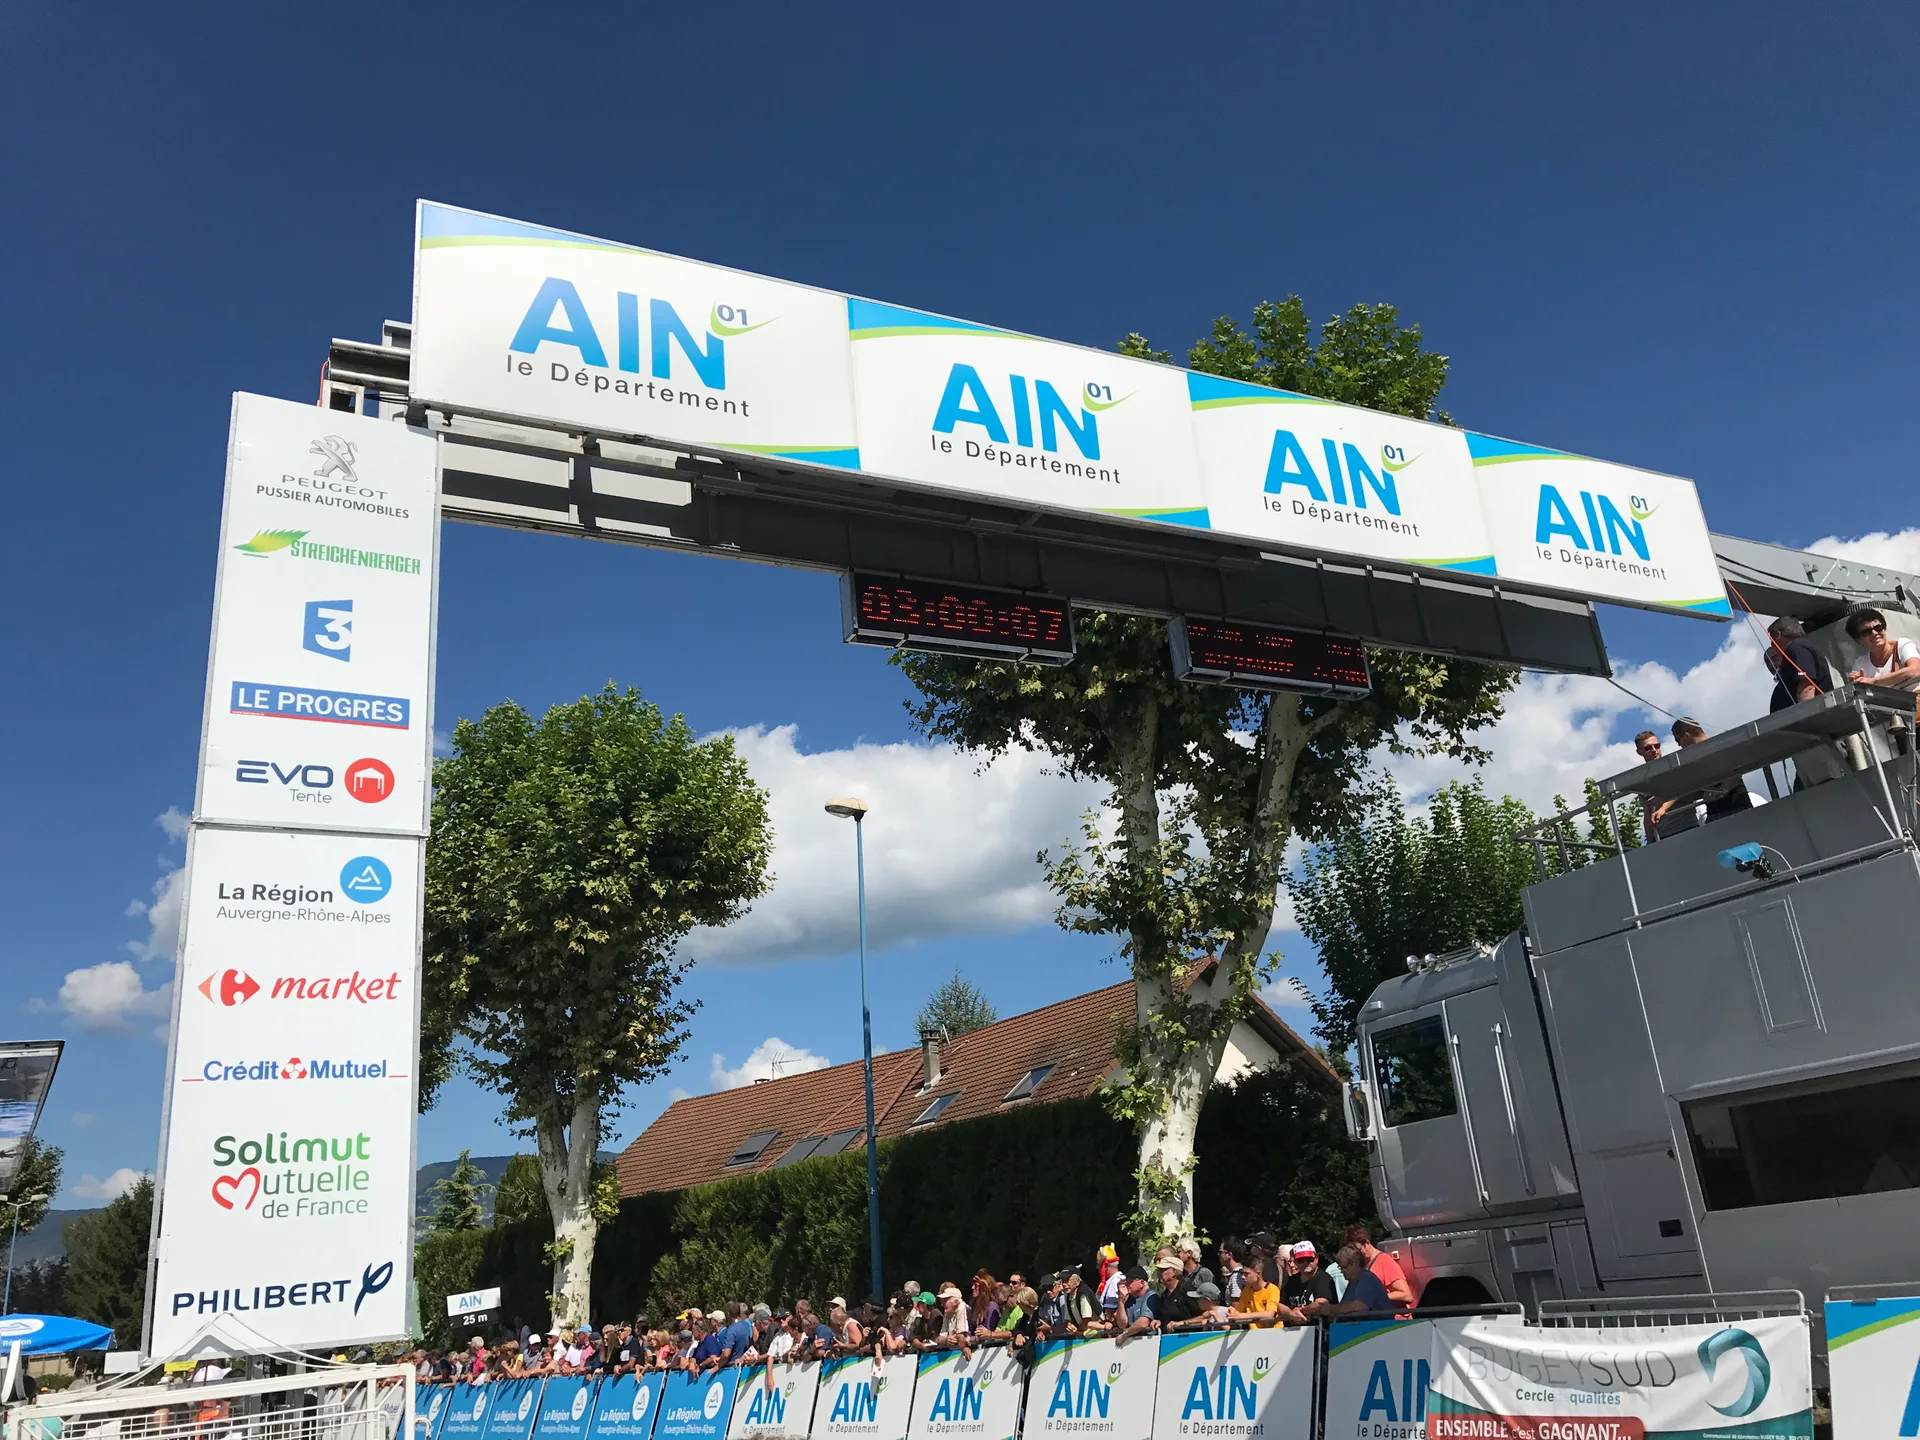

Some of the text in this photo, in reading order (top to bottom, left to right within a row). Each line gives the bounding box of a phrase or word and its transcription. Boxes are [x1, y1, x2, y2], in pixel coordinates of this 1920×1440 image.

[716, 303, 748, 326] 01
[508, 276, 726, 390] AIN
[507, 354, 750, 417] le Département
[1086, 382, 1113, 401] 01
[932, 362, 1101, 461] AIN
[931, 434, 1121, 484] le Département
[1383, 444, 1405, 462] 01
[1263, 429, 1402, 517] AIN
[281, 474, 389, 500] PEUGEOT
[256, 484, 410, 519] PUSSIER AUTOMOBILES
[1630, 493, 1649, 512] 01
[1263, 495, 1420, 537] le Département
[1535, 483, 1651, 561] AIN
[290, 539, 421, 575] STREICHENBERGER
[1536, 545, 1668, 581] le Département
[314, 607, 353, 651] 3
[238, 687, 403, 722] LE PROGRÈS
[236, 759, 334, 789] EVO
[289, 788, 333, 804] Tente
[218, 882, 334, 905] La Région
[216, 906, 391, 925] Auvergne-Rhône-Alpes
[270, 970, 402, 1004] market
[203, 1059, 387, 1081] Crédit Mutuel
[213, 1131, 371, 1167] Solimut
[262, 1198, 369, 1219] de France
[172, 1279, 352, 1317] PHILIBERT
[459, 1295, 482, 1309] AIN
[463, 1313, 488, 1326] 25 m
[1110, 1362, 1122, 1374] 01
[1256, 1356, 1269, 1370] 01
[787, 1382, 795, 1391] 01
[879, 1376, 888, 1386] 01
[983, 1370, 993, 1381] 01
[830, 1382, 878, 1422] AIN
[929, 1377, 983, 1422] AIN
[1047, 1369, 1111, 1418] AIN
[1181, 1365, 1258, 1420] AIN
[1515, 1388, 1621, 1406] Cercle qualités
[600, 1408, 631, 1424] La Région
[666, 1406, 702, 1423] La Région
[745, 1387, 786, 1424] AIN
[828, 1423, 879, 1434] le Département
[927, 1422, 984, 1434] le Département
[1045, 1420, 1114, 1433] le Département
[1179, 1421, 1264, 1436] le Département
[1357, 1423, 1427, 1440] le Départe
[1436, 1419, 1508, 1438] ENSEMBLE
